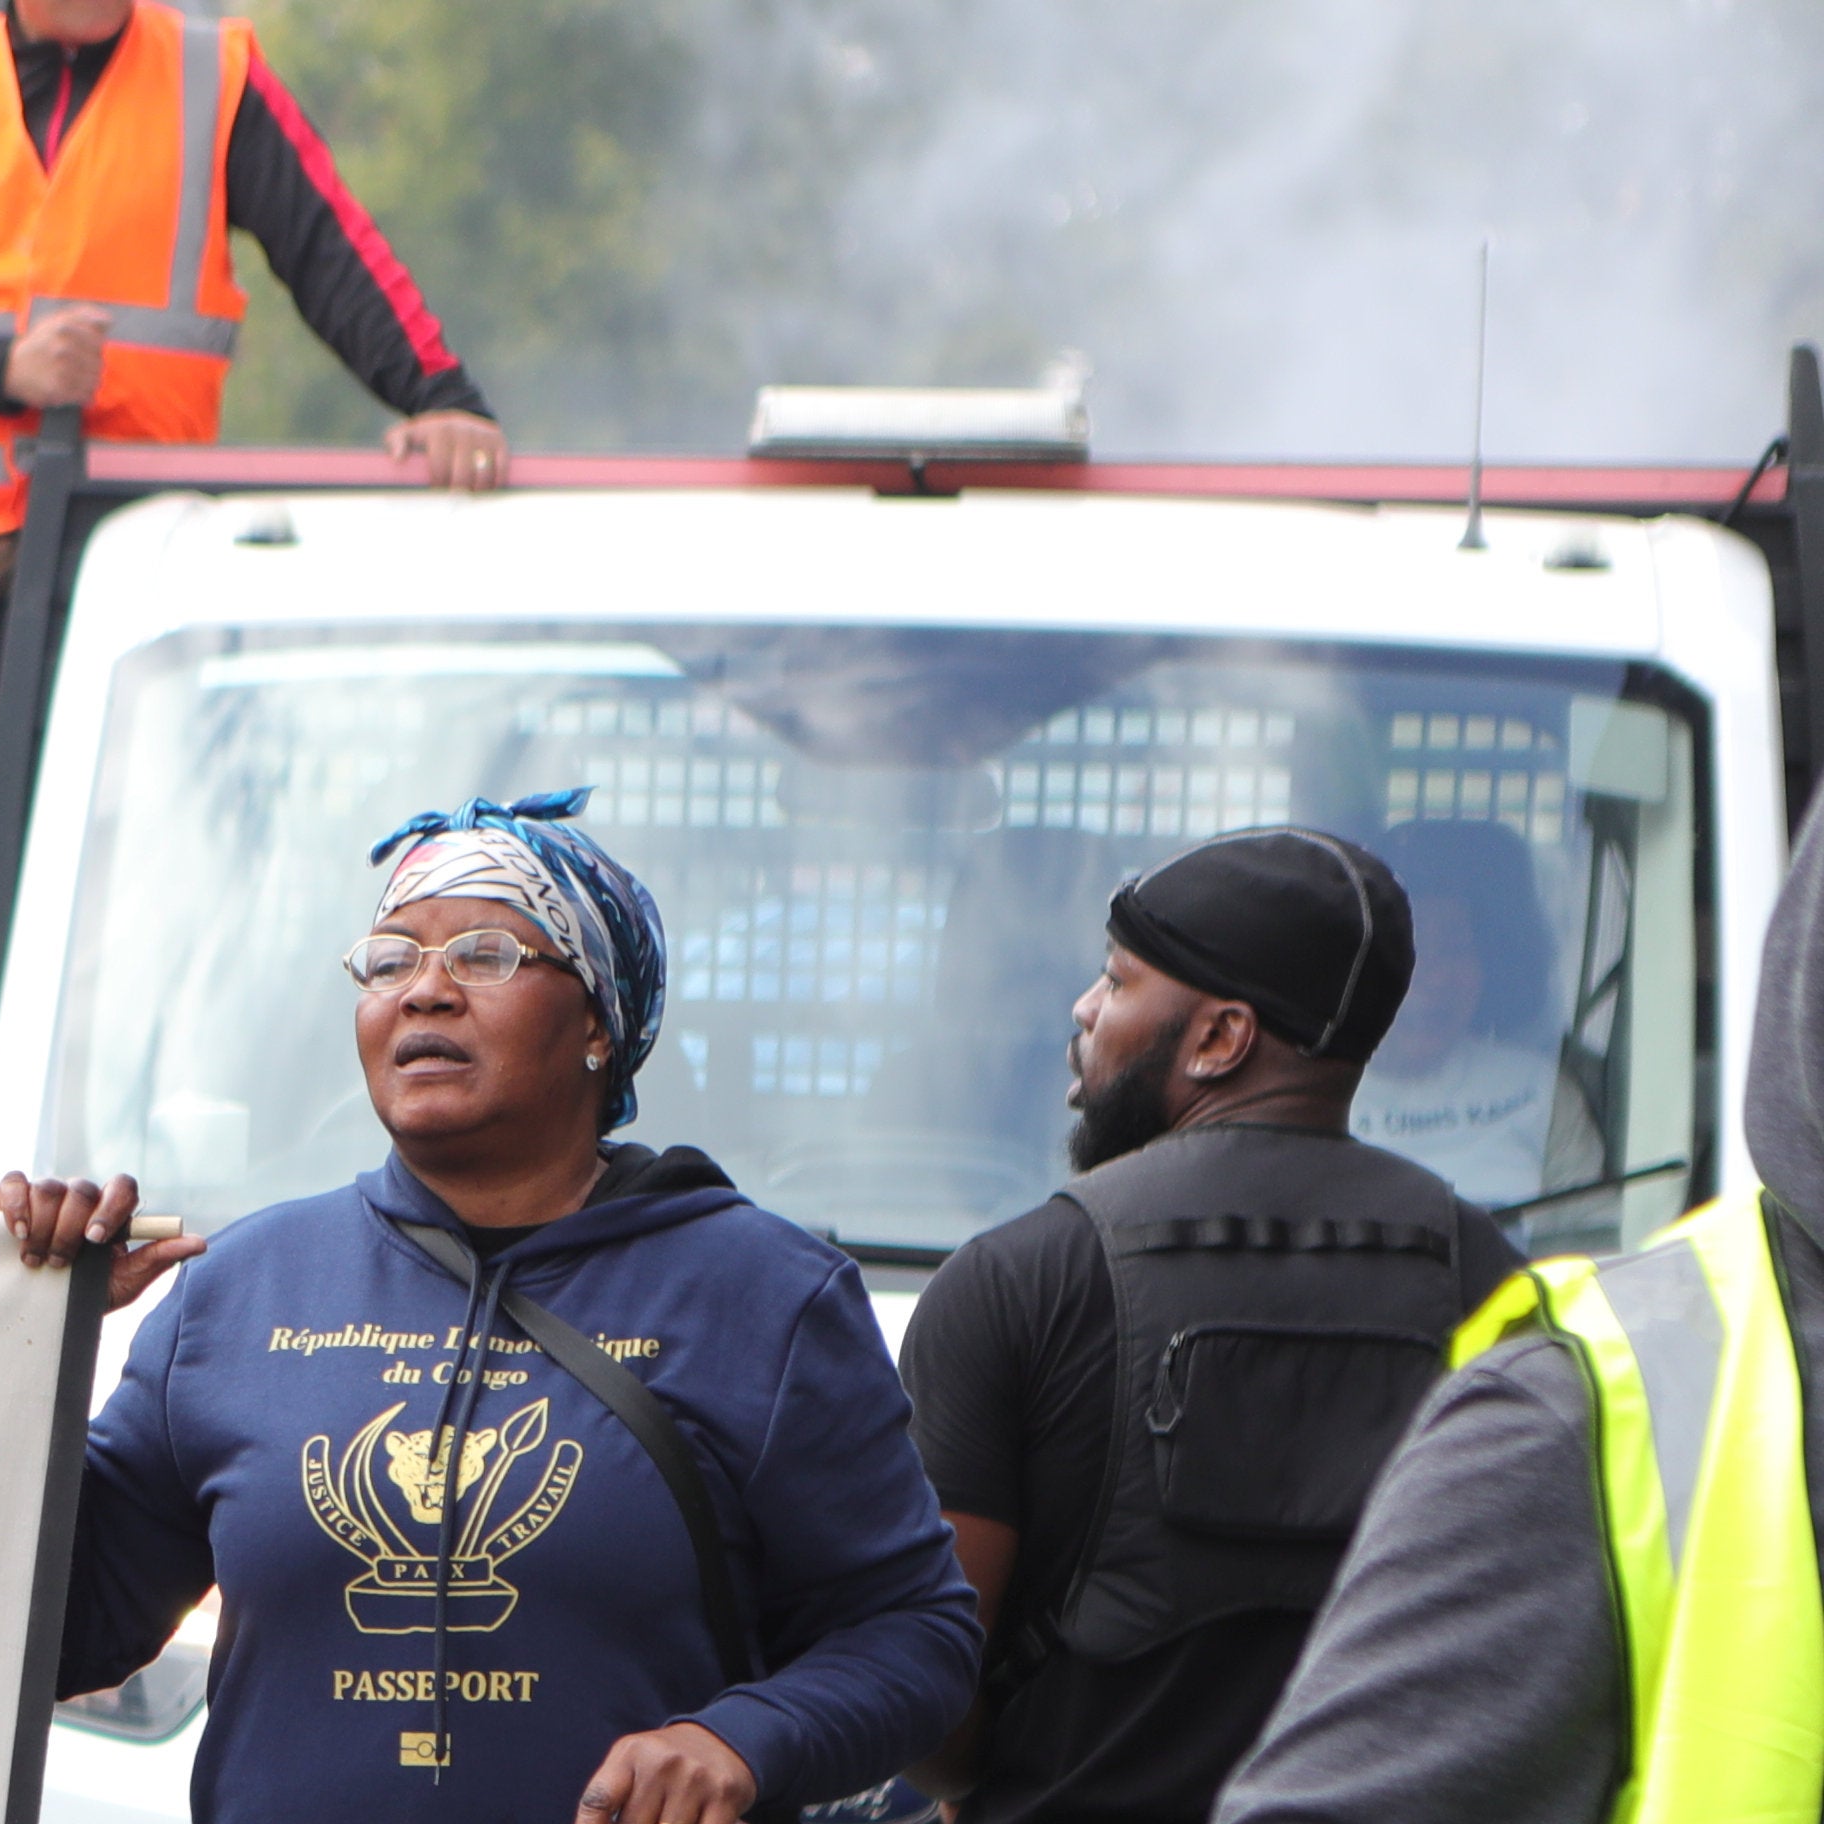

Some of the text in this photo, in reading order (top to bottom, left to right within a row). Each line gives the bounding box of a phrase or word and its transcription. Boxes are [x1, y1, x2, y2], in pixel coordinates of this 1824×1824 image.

[268, 1323, 435, 1356] République
[383, 1361, 421, 1385] du
[308, 1458, 368, 1548] JUSTICE
[496, 1464, 575, 1550] TRAVAIL
[393, 1563, 465, 1579] PAX
[332, 1670, 540, 1702] PASSEPORT
